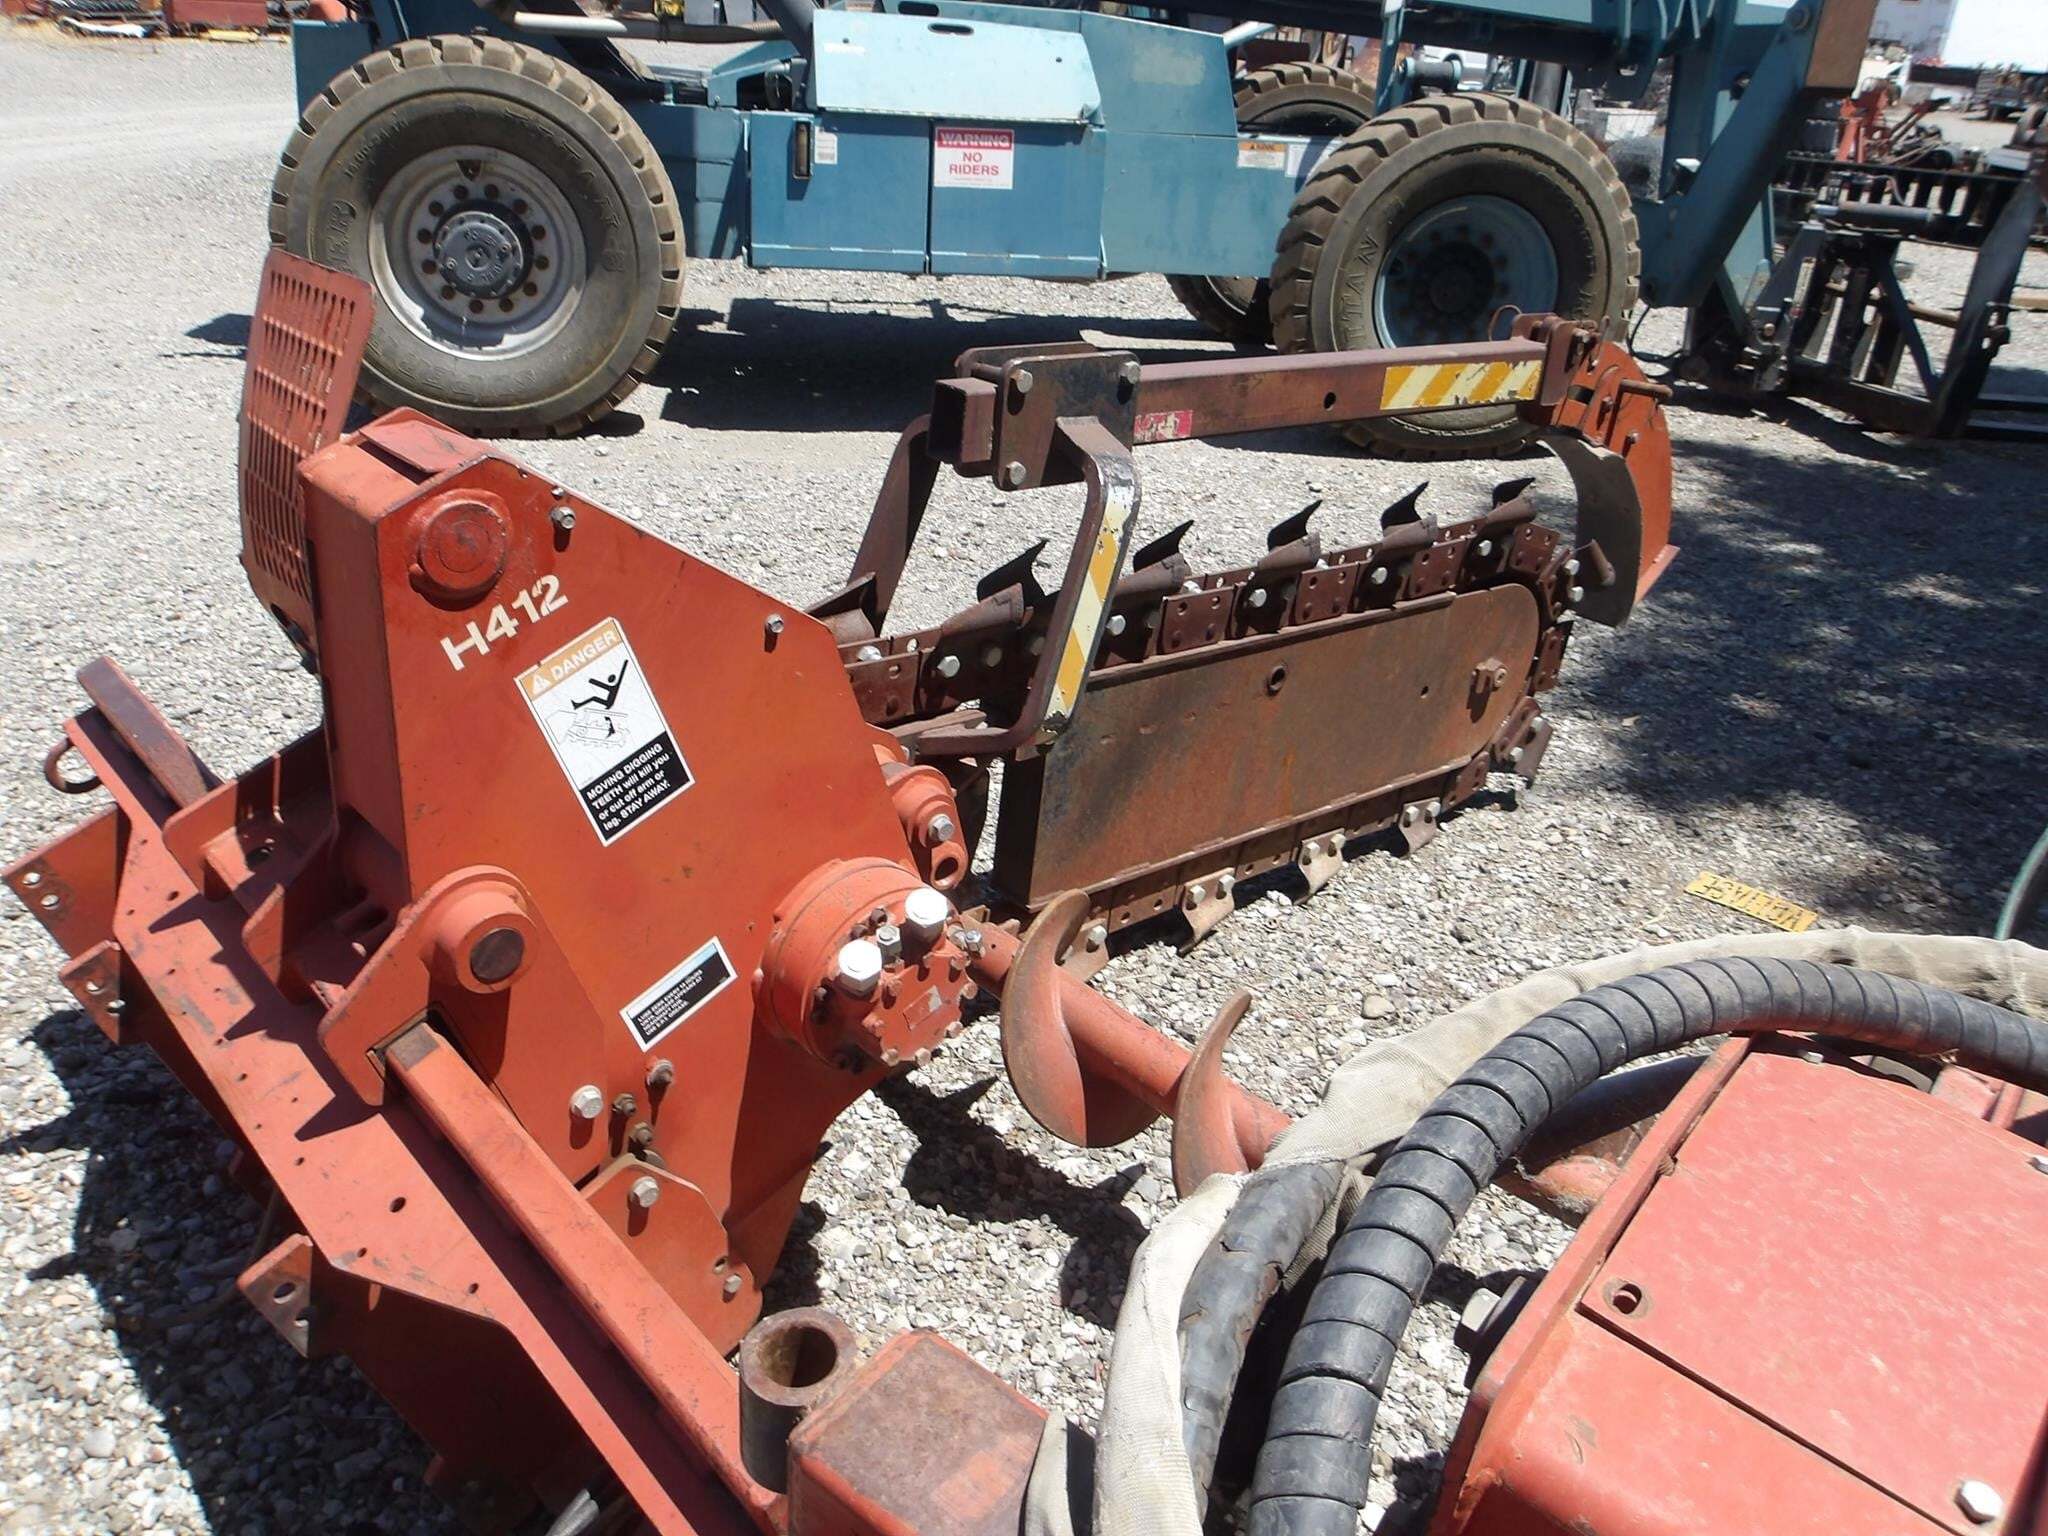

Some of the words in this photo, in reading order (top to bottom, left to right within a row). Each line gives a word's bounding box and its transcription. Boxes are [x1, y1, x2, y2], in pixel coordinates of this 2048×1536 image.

[940, 132, 1010, 147] WARNING
[963, 151, 983, 163] NO
[949, 164, 1000, 176] RIDERS
[440, 574, 569, 672] H412
[550, 630, 618, 681] DANGER
[586, 770, 625, 800] MOVING
[623, 743, 663, 774] DIGGING
[592, 784, 623, 809] TEETH
[622, 773, 639, 789] will
[638, 763, 653, 778] kill
[652, 753, 670, 770] you
[598, 809, 609, 820] or
[609, 798, 625, 812] cut
[624, 788, 637, 802] off
[637, 777, 655, 793] arm
[654, 770, 665, 781] or
[620, 797, 643, 818] STAY
[643, 779, 671, 803] AWAY.
